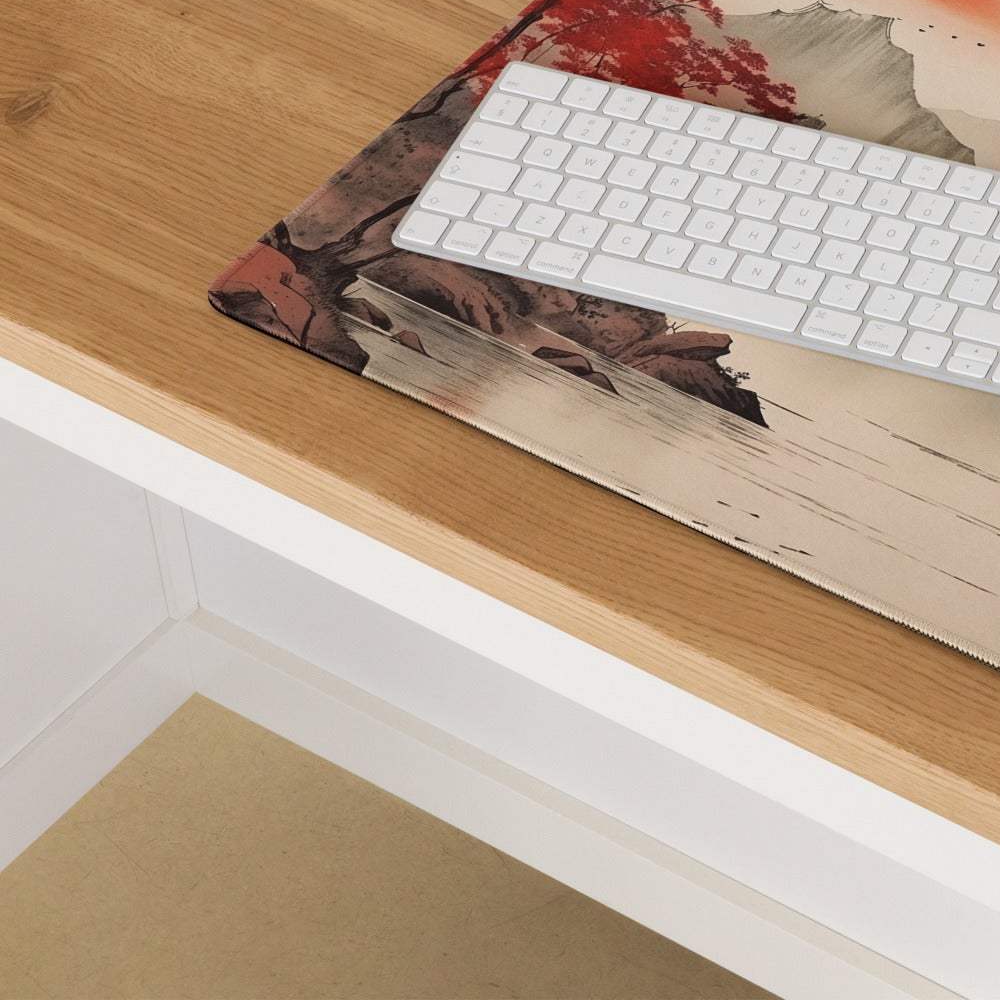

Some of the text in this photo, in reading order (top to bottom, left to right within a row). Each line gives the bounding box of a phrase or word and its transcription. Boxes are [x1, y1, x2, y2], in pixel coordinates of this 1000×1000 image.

[543, 148, 940, 247] Q W E R T Y U I O P
[618, 200, 629, 209] D
[662, 210, 672, 218] F
[705, 221, 715, 229] G
[748, 231, 759, 240] H
[792, 241, 801, 250] J
[835, 252, 844, 260] K
[535, 215, 807, 287] Z X C V B N M
